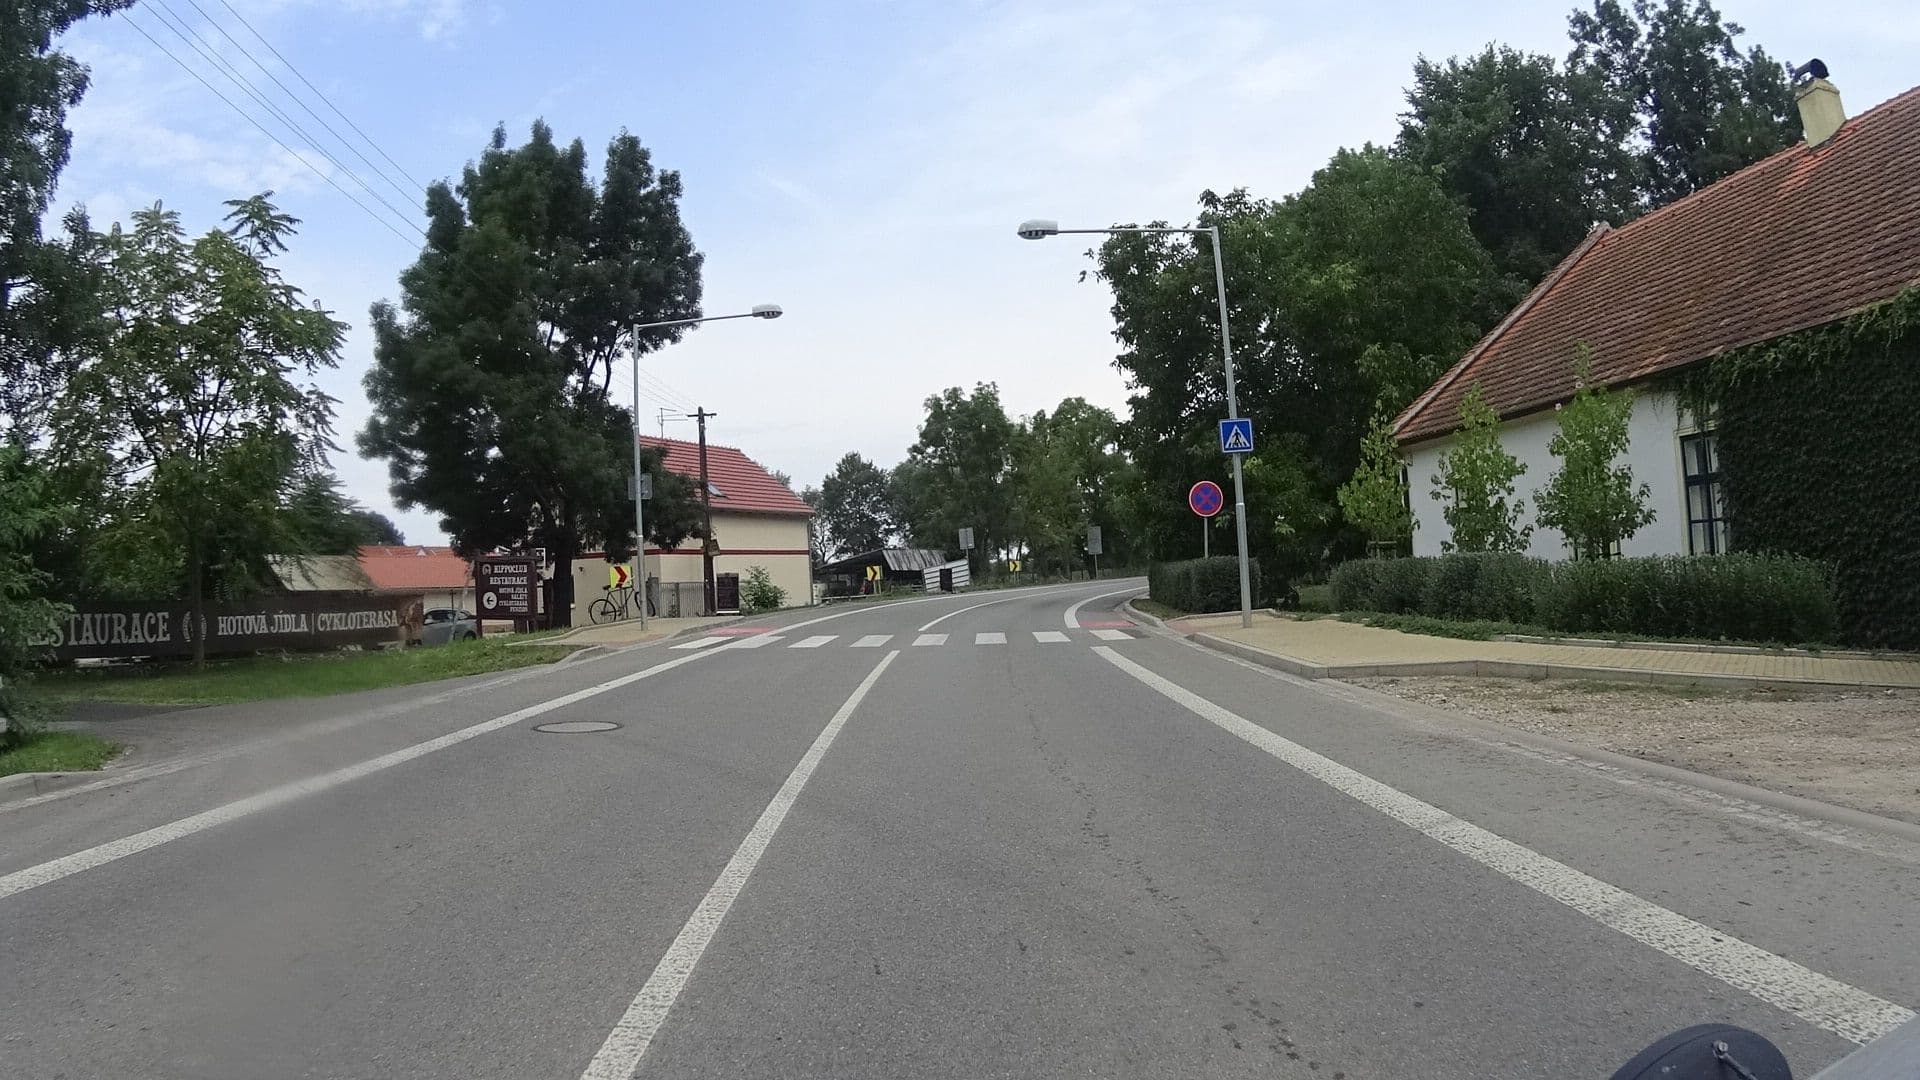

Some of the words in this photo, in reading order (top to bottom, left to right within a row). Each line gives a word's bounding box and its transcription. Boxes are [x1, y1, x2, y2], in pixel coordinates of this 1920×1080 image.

[494, 565, 528, 573] HIPPOCLUB
[489, 577, 528, 585] RESTAURACE
[218, 610, 268, 636] HOTOVÁ
[271, 610, 309, 633] JÍDLA
[317, 609, 400, 632] CYKLOTERASA
